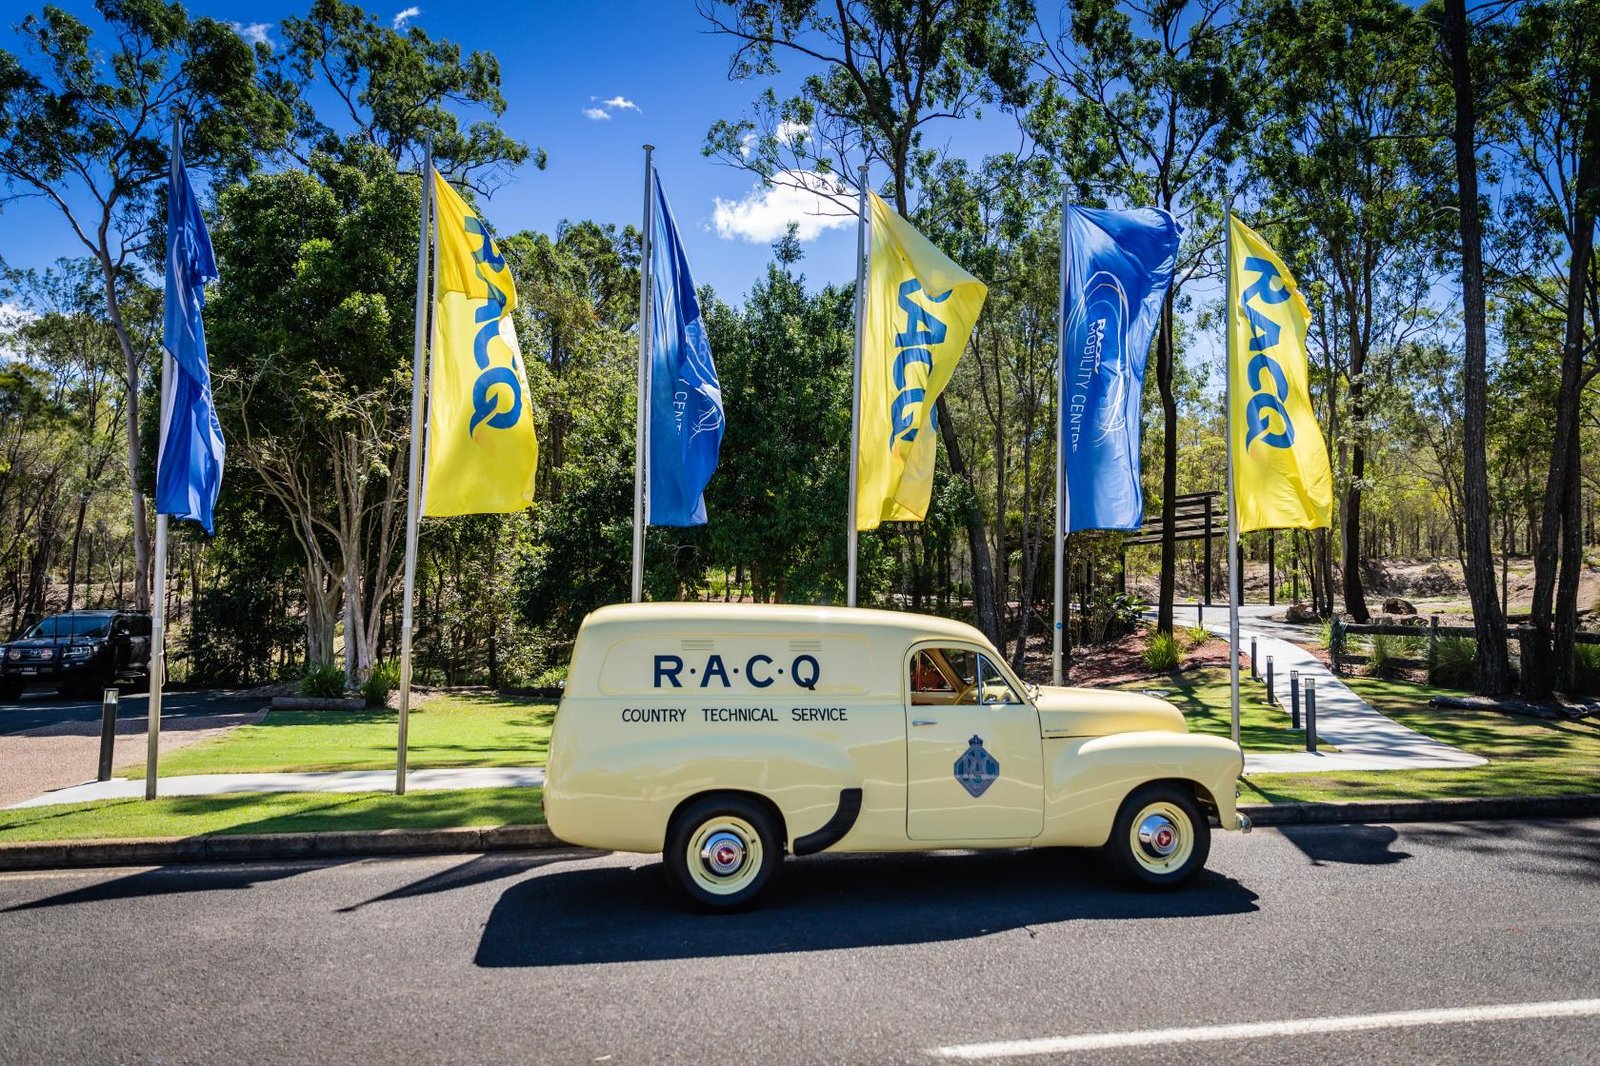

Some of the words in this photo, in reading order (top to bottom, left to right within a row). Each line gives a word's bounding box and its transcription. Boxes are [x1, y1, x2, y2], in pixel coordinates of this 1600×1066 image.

[1074, 321, 1096, 390] MOBILITY
[1241, 256, 1296, 455] RACQ
[621, 708, 687, 723] COUNTRY
[701, 708, 779, 723] TECHNICAL
[791, 707, 849, 722] SERVICE
